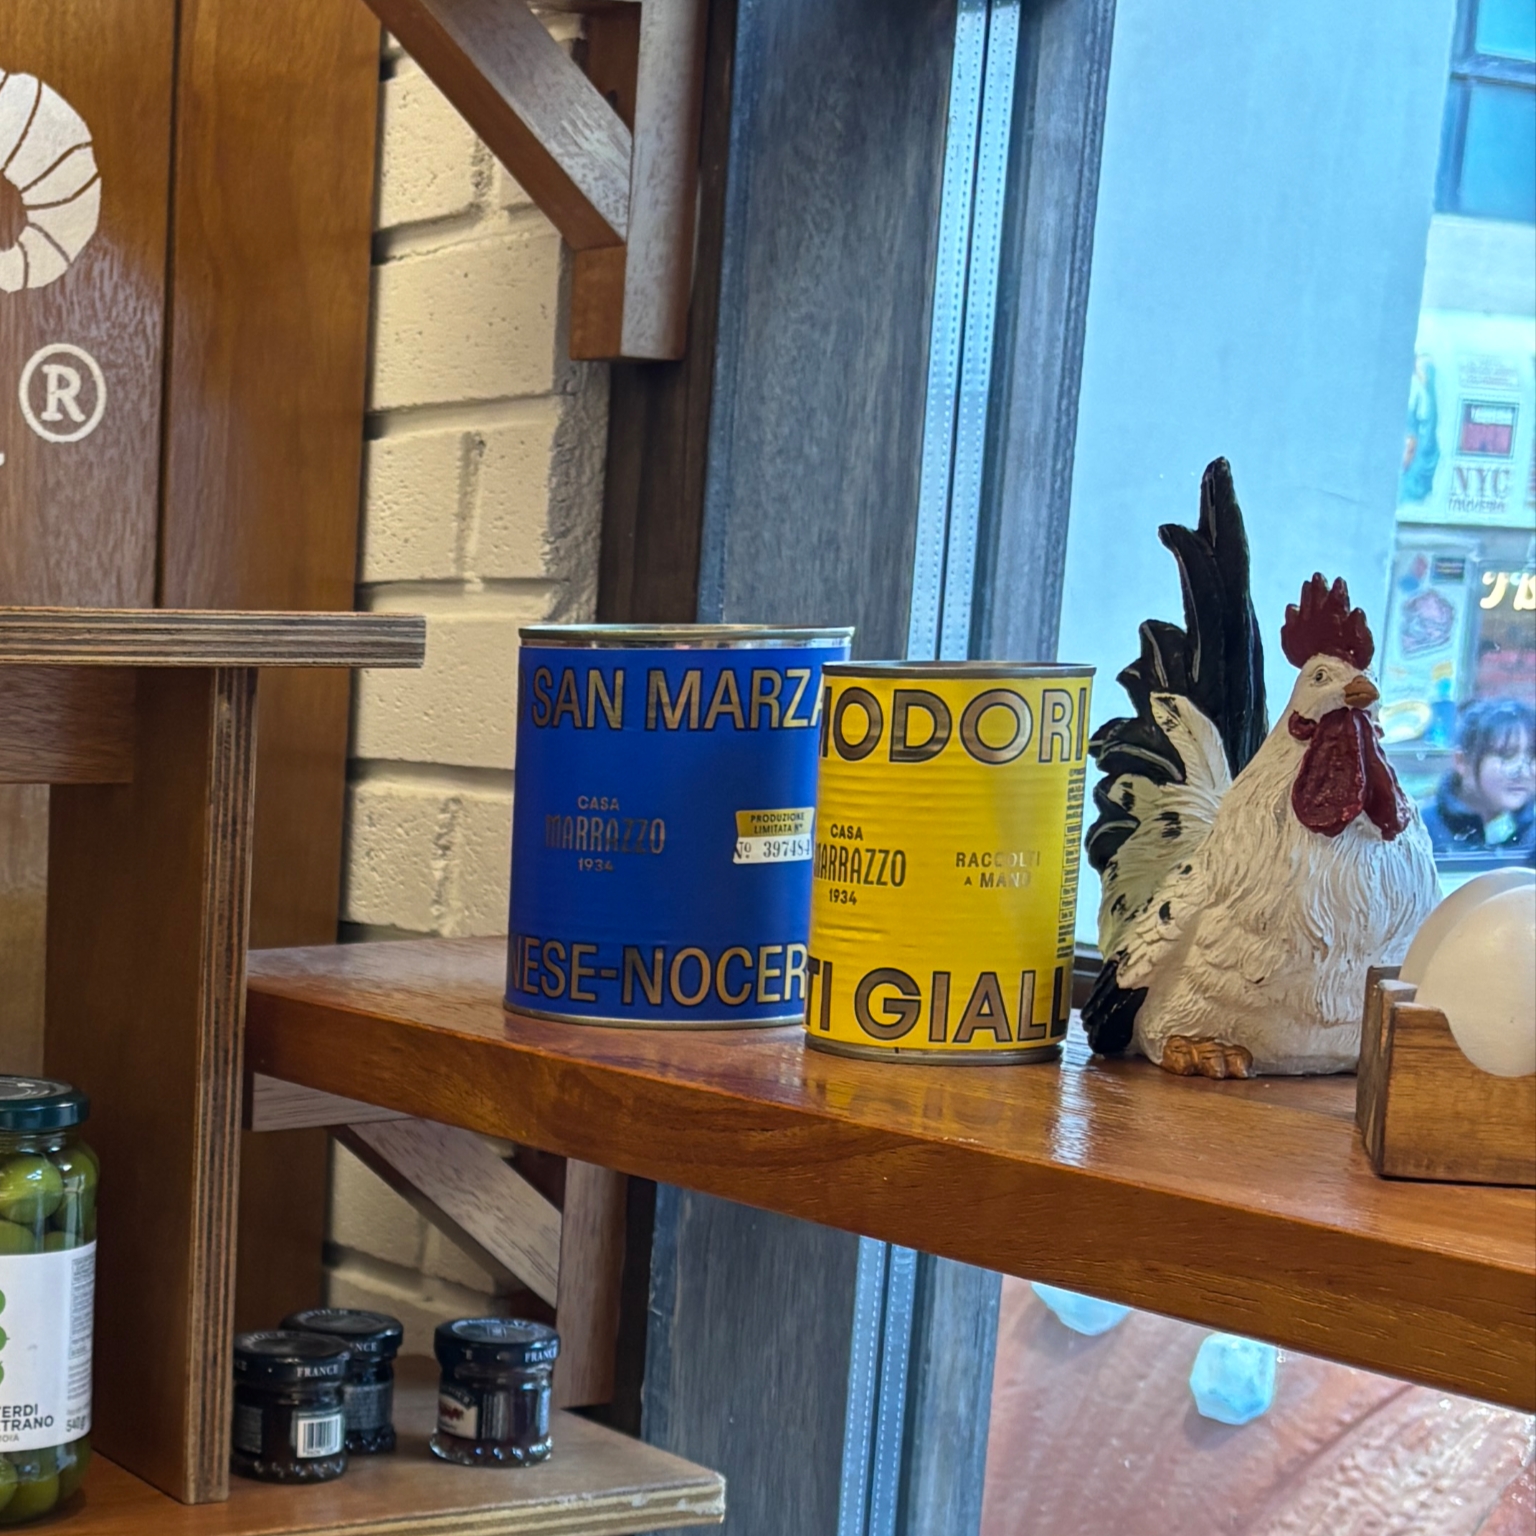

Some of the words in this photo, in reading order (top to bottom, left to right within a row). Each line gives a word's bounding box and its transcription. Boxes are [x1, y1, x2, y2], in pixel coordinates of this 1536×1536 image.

[531, 666, 624, 730] SAN
[577, 795, 620, 811] CASA
[750, 812, 805, 823] PRODUZIONE
[545, 814, 666, 854] MARRAZZO
[753, 824, 792, 834] LIMITATA
[830, 823, 863, 841] CASA
[763, 839, 811, 858] 397484
[577, 857, 614, 872] 1934
[955, 851, 1041, 869] RACCOLTI
[979, 872, 1032, 888] MANO
[829, 887, 857, 906] 1934
[297, 1364, 339, 1377] FRANCE
